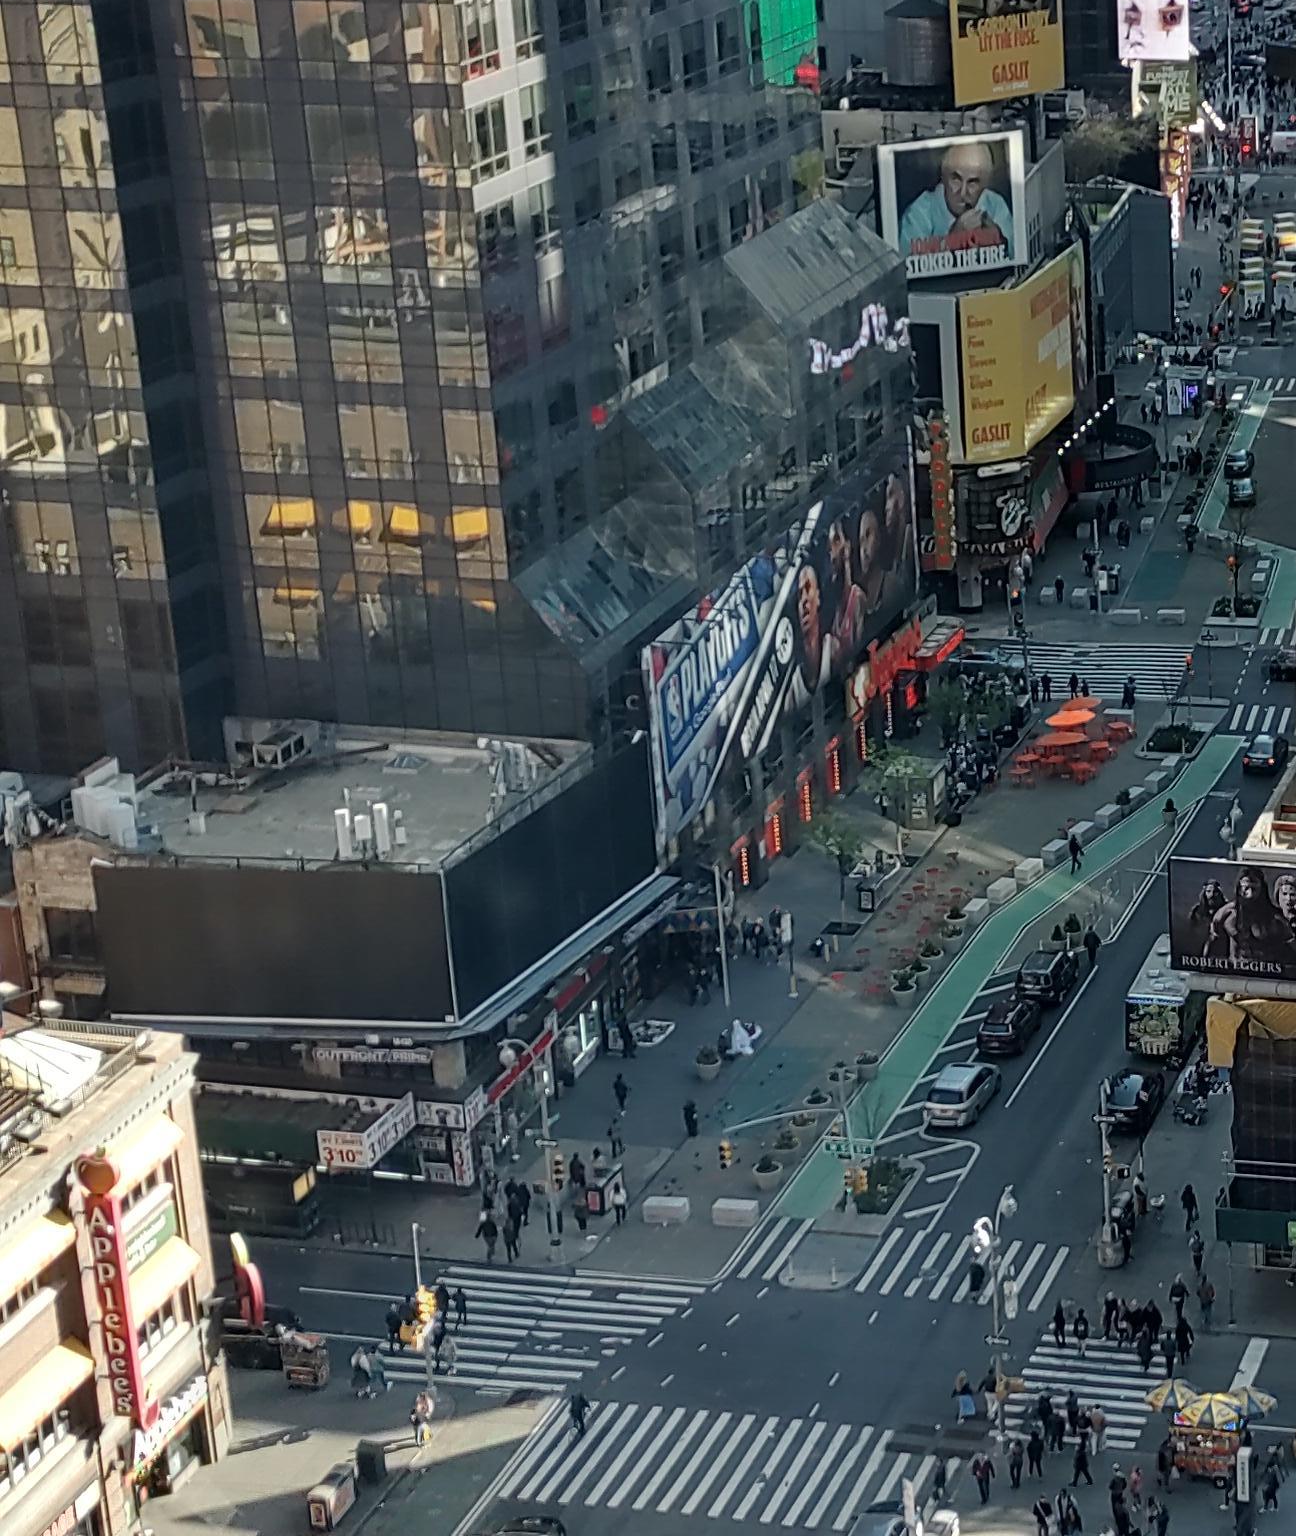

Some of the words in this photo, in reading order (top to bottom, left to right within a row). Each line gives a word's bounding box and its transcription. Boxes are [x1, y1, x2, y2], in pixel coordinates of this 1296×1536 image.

[992, 60, 1029, 84] GASLIT
[906, 250, 954, 275] STOKED
[954, 248, 980, 268] THE
[980, 244, 1010, 265] FIRE.
[972, 423, 1011, 445] GASLIT
[1182, 955, 1228, 969] ROBERT
[1233, 957, 1282, 974] EGGERS
[316, 1049, 385, 1063] OUTFRONT
[392, 1050, 429, 1063] PRIME
